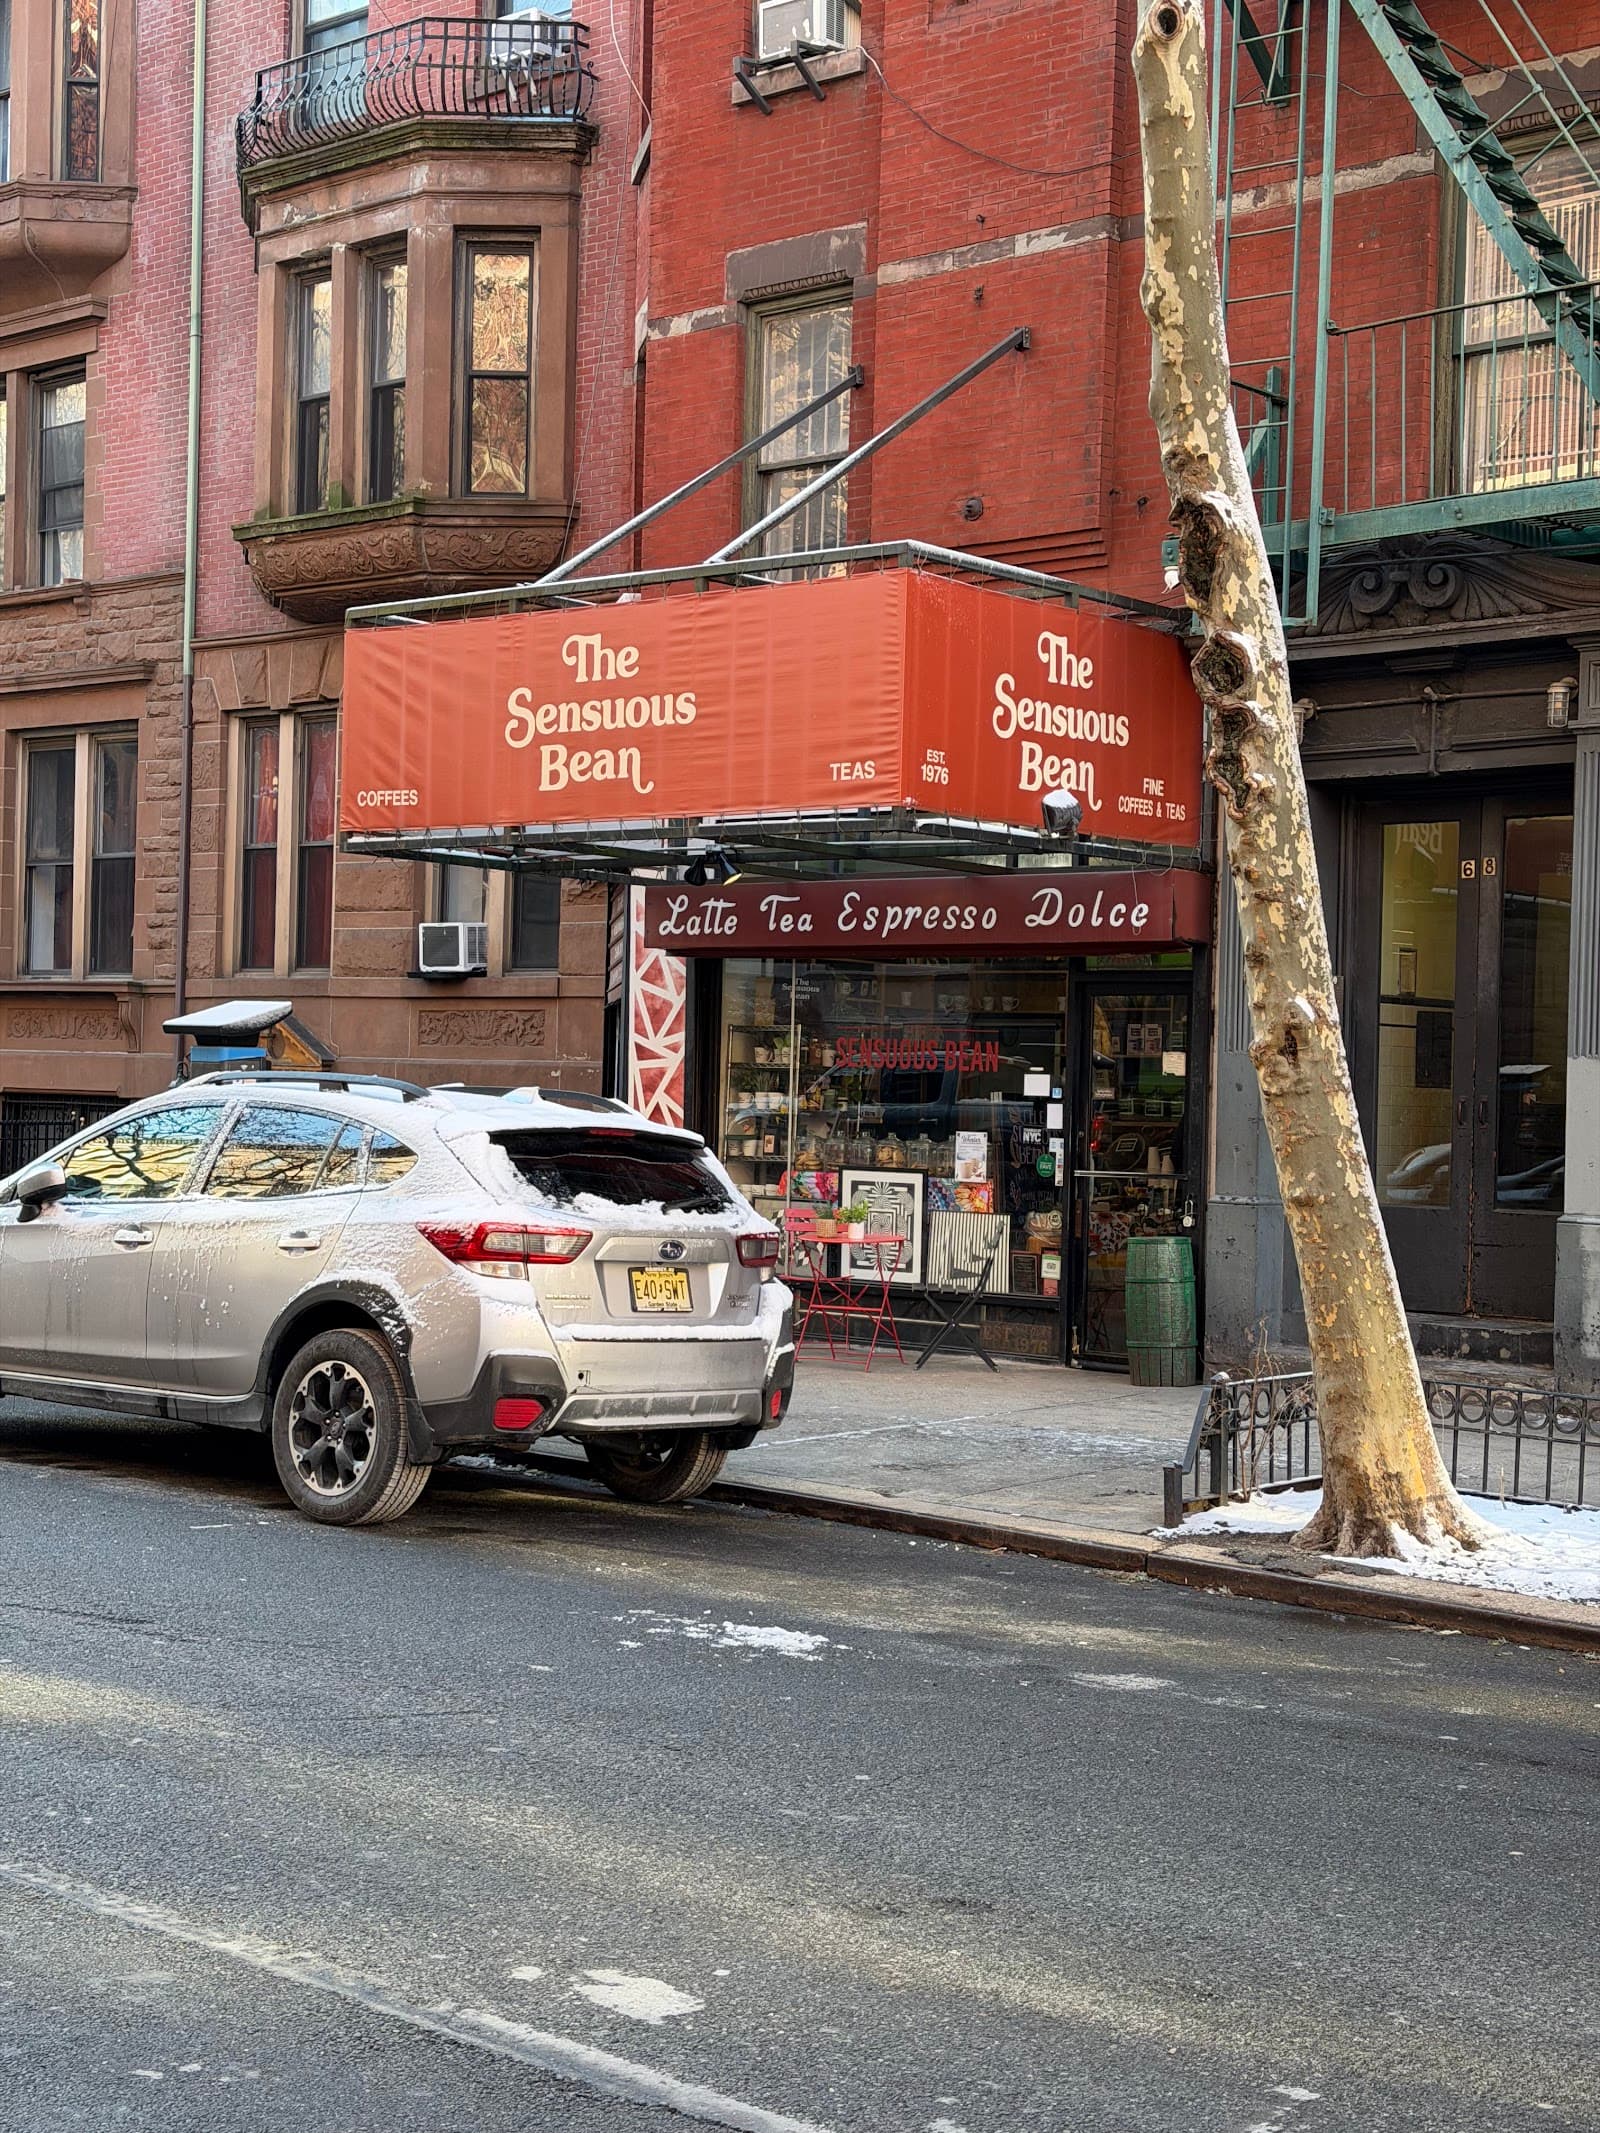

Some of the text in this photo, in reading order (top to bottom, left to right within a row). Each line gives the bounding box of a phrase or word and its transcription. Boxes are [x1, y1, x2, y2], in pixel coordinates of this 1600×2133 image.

[561, 632, 640, 683] The
[1037, 630, 1094, 689] The
[504, 687, 697, 748] Sensuous
[992, 672, 1130, 747] Sensuous
[538, 744, 655, 794] Bean
[829, 760, 876, 782] TEAS
[920, 763, 949, 785] 1976
[926, 748, 946, 766] EST.
[1018, 740, 1103, 812] Bean
[1143, 777, 1165, 797] FINE
[357, 788, 418, 807] COFFEES
[1118, 795, 1186, 822] COFFEES & TEAS
[658, 887, 1149, 938] Latte Tea Espresso Dolce
[836, 1036, 1000, 1073] SENSUOUS BEAN
[1023, 1131, 1042, 1143] NYC
